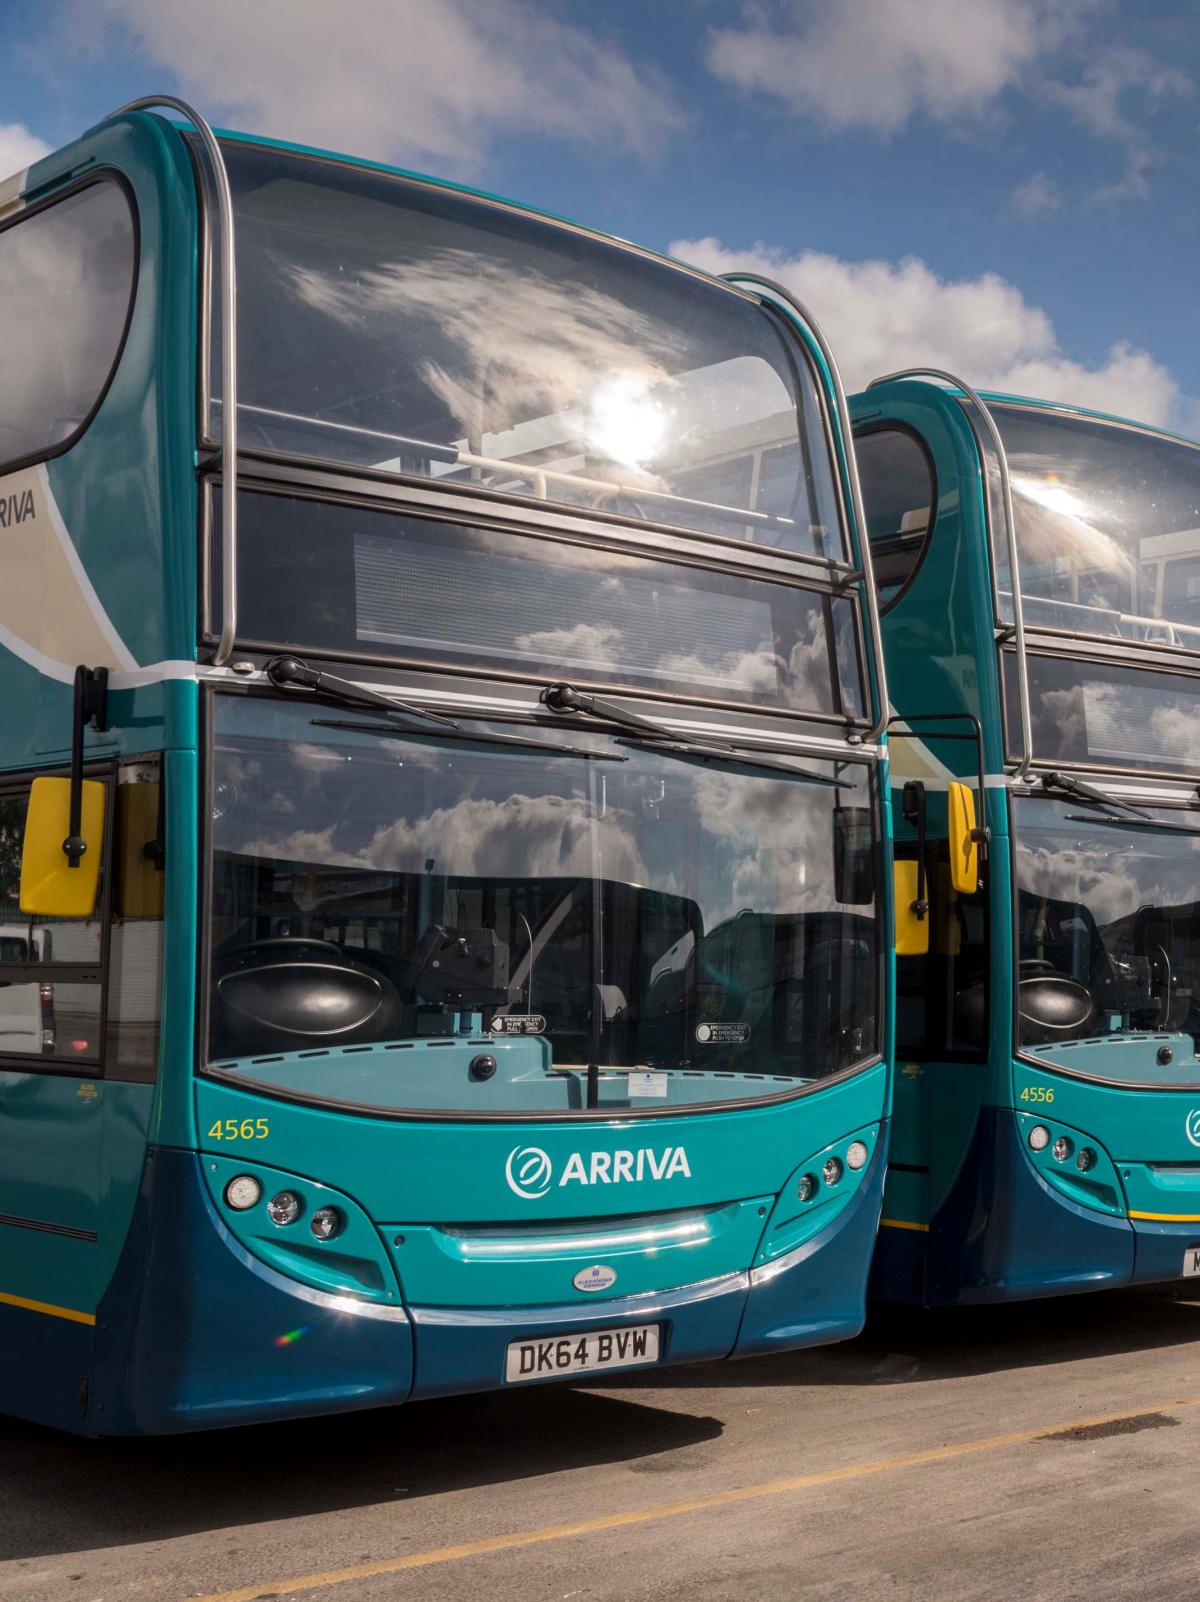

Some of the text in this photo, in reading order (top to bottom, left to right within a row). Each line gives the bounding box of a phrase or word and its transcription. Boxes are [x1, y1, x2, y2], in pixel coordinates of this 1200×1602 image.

[1020, 1087, 1055, 1103] 4556
[208, 1118, 269, 1140] 4565
[559, 1146, 692, 1187] ARRIVA
[519, 1329, 648, 1374] DK64 BVW
